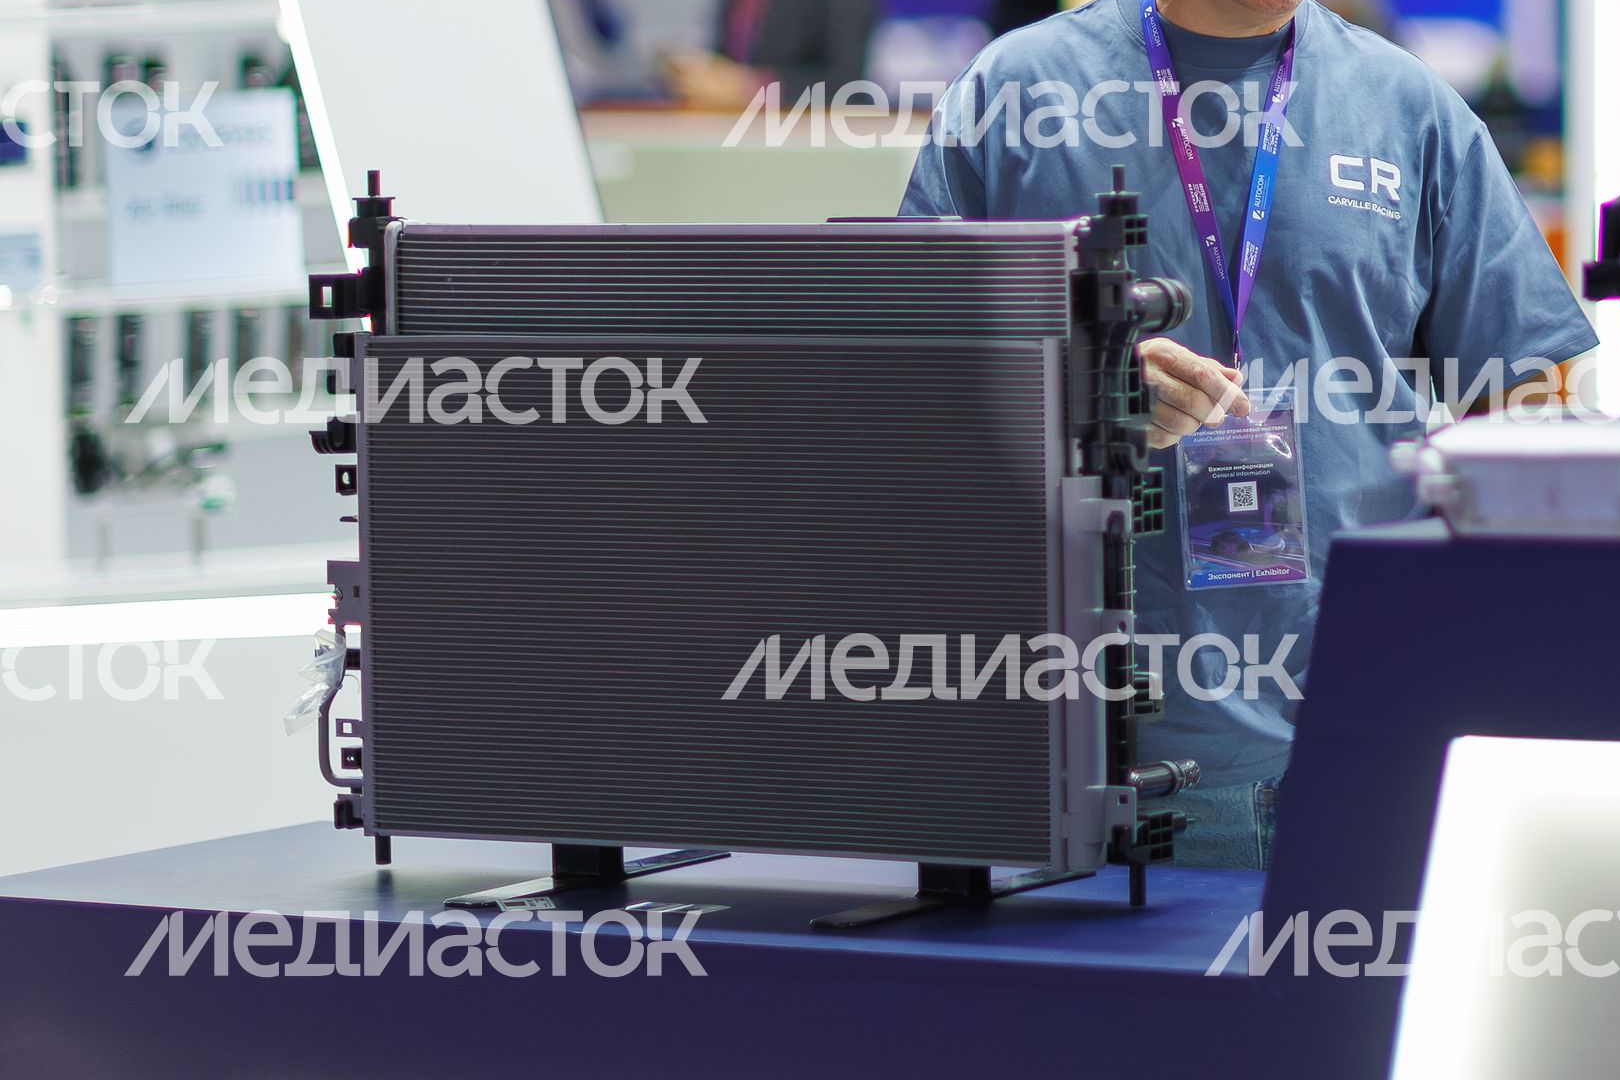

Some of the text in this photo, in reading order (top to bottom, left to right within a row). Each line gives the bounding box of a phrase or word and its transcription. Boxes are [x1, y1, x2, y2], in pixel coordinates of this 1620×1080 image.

[1150, 16, 1161, 47] AUTOCOM
[1180, 128, 1194, 160] AUTOCOM
[1254, 175, 1265, 207] AUTOCOM
[1330, 154, 1401, 201] CR
[1328, 195, 1401, 220] CARVILLE RACING
[1213, 246, 1225, 280] AUTOCOM
[1208, 462, 1274, 473] Важная информация
[1212, 471, 1236, 479] General
[1207, 571, 1250, 581] Экспонент
[1255, 568, 1290, 577] Exhibitor
